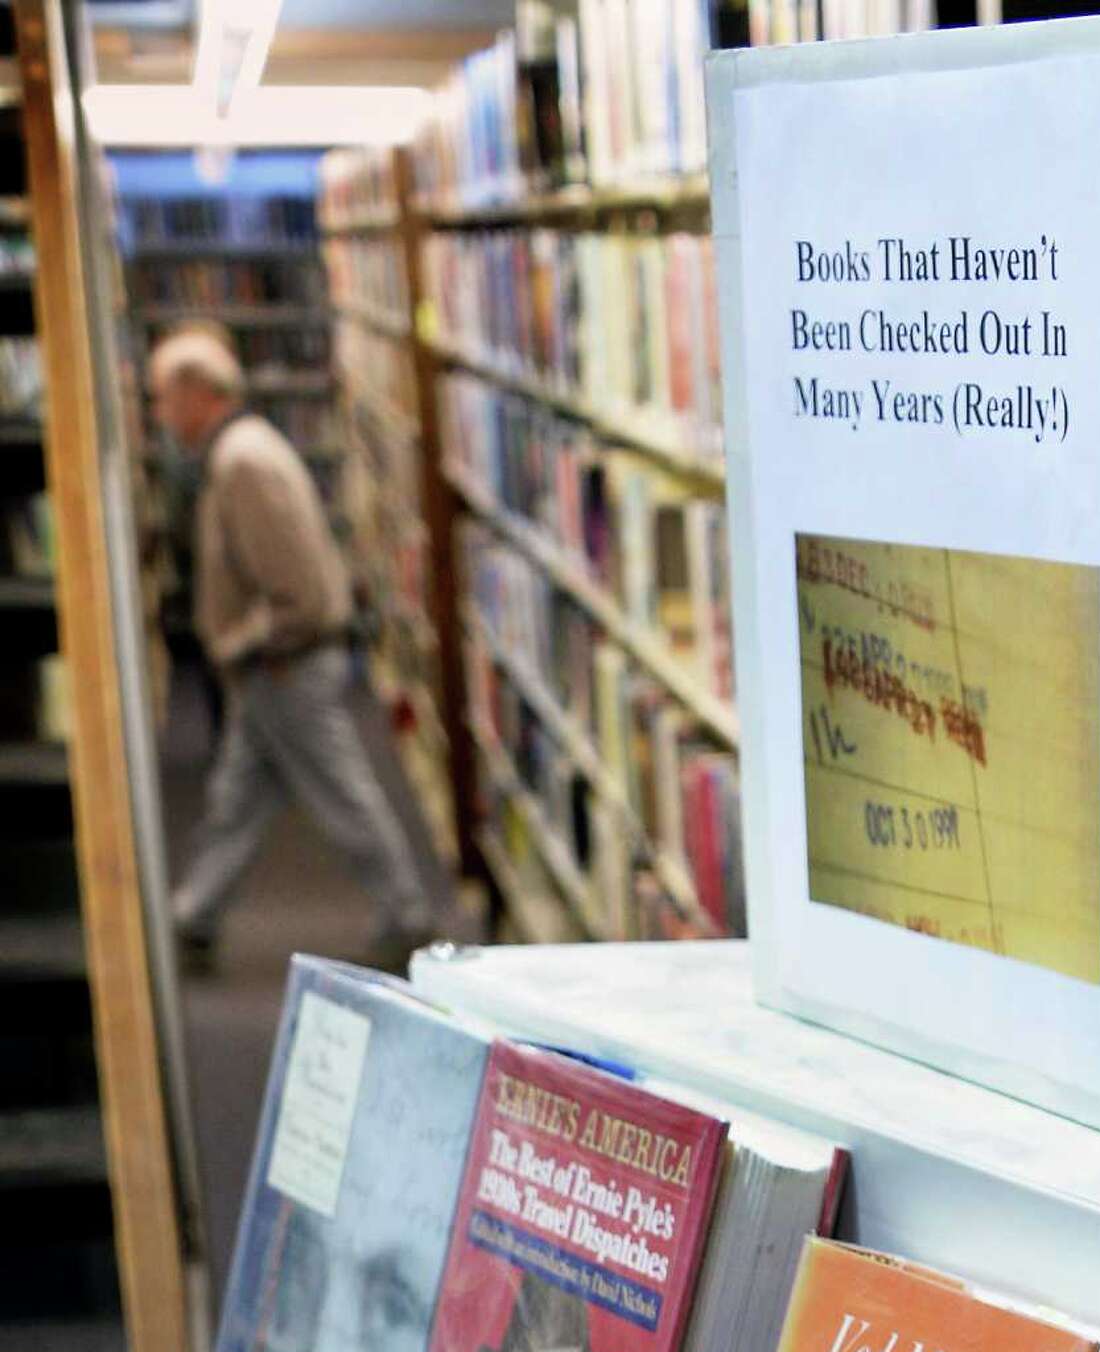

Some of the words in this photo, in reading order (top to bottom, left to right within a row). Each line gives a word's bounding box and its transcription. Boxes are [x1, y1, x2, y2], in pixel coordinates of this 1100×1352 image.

[795, 238, 871, 283] Books
[877, 237, 941, 281] That
[948, 234, 1060, 283] Haven't
[790, 309, 851, 352] Been
[859, 308, 969, 356] Checked
[978, 309, 1033, 357] Out
[1041, 310, 1069, 358] In
[792, 376, 864, 431] Many
[870, 379, 944, 425] Years
[952, 382, 1069, 444] (Really!)
[494, 1069, 581, 1143] ERNIE'S
[579, 1109, 692, 1188] AMERICA
[489, 1129, 519, 1168] The
[518, 1139, 556, 1188] Best
[553, 1159, 577, 1197] of
[571, 1163, 623, 1219] Ernie
[623, 1186, 676, 1241] Pyle's
[571, 1207, 670, 1284] Dispatches
